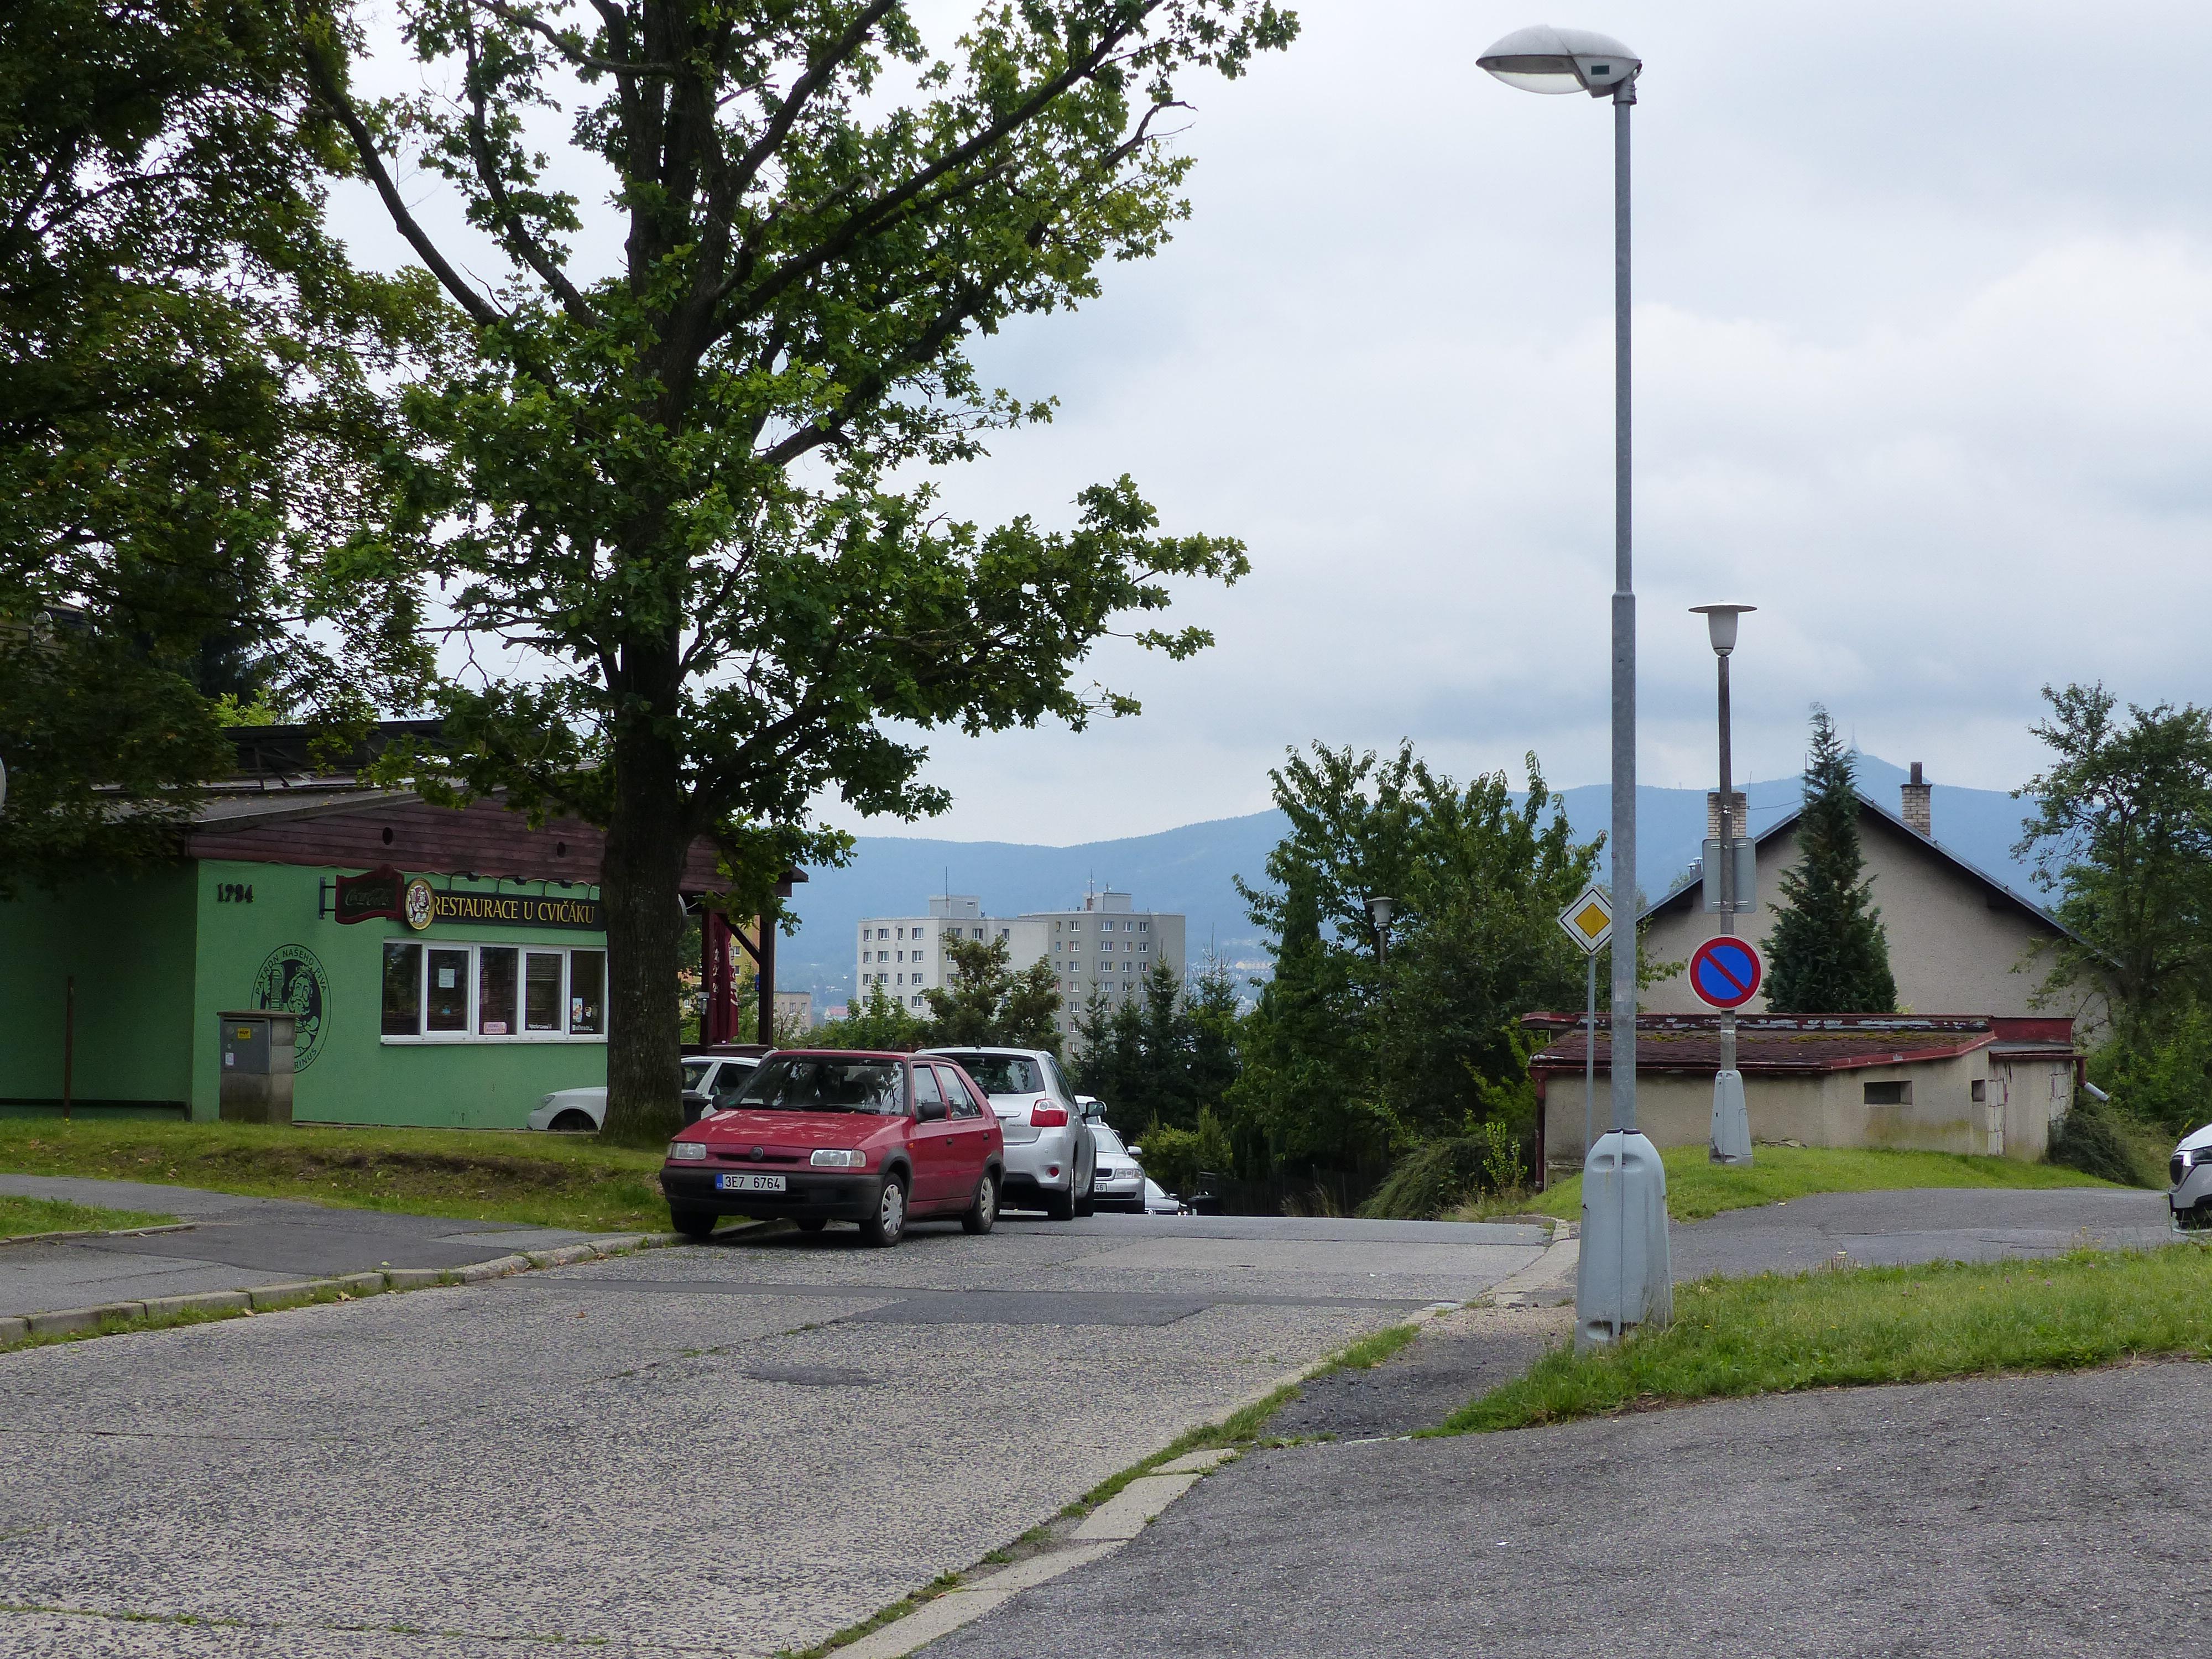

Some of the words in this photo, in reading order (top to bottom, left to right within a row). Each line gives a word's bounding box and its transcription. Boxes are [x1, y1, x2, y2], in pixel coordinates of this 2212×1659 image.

[435, 895, 518, 920] RESTAURACE
[523, 901, 534, 920] U
[538, 900, 595, 924] CVIČÁKU
[255, 954, 279, 995] PATRON
[282, 946, 314, 966] NAŠEHO
[315, 968, 327, 993] PIVA
[294, 1048, 317, 1069] RINUS
[725, 1176, 745, 1188] 3E7
[753, 1177, 780, 1189] 6764
